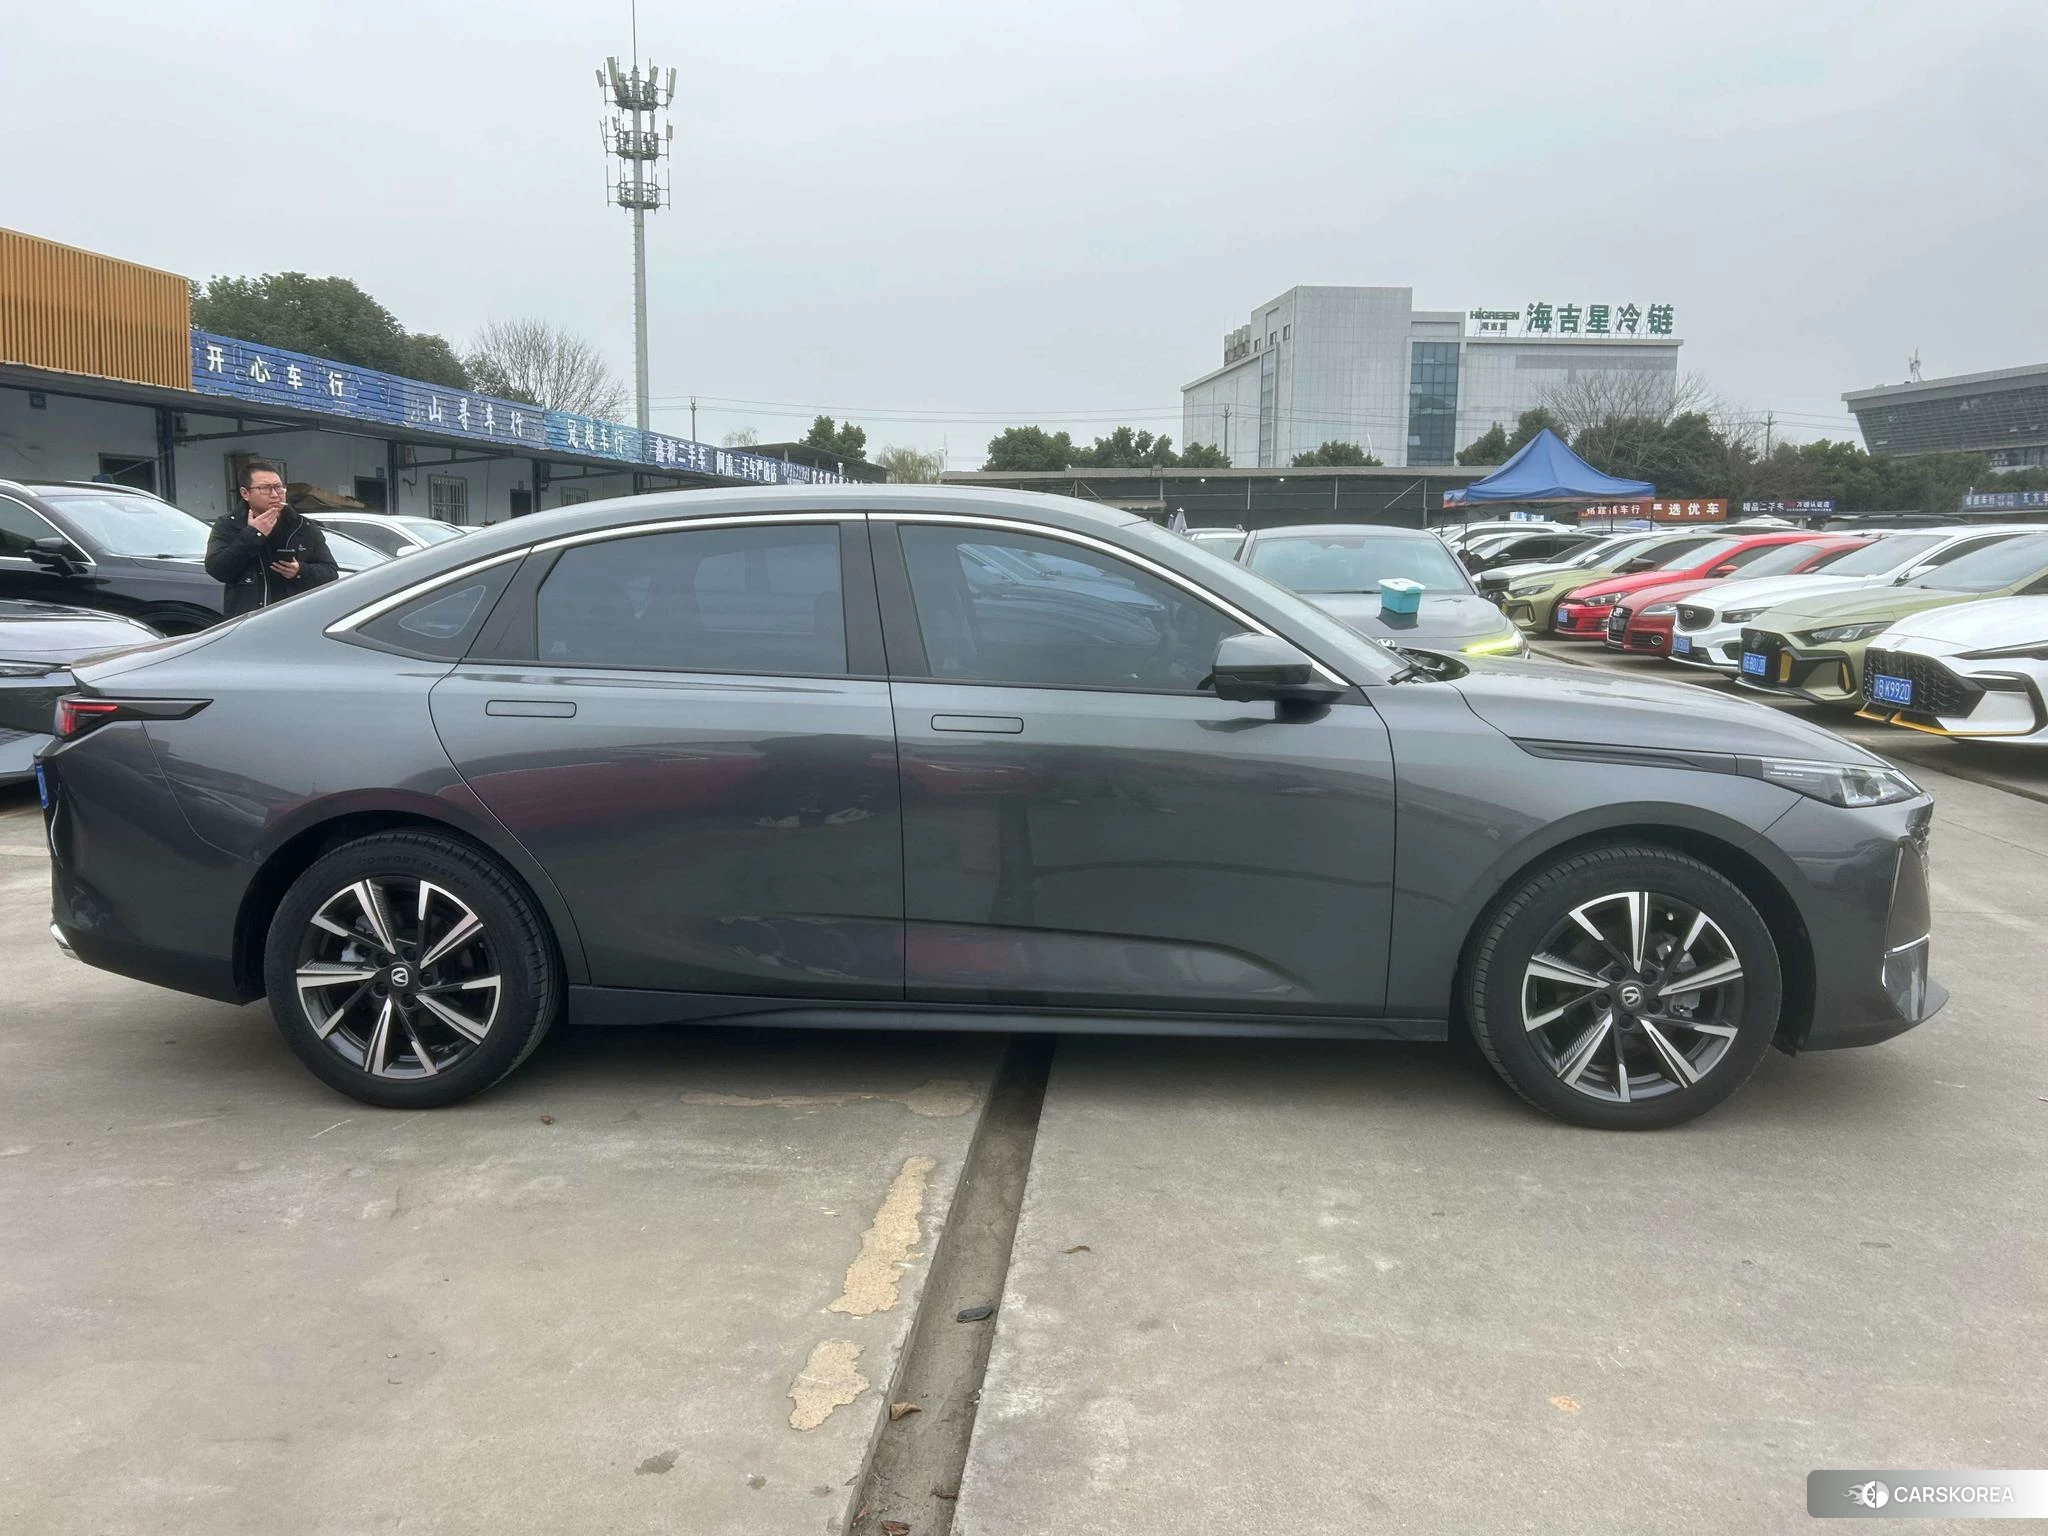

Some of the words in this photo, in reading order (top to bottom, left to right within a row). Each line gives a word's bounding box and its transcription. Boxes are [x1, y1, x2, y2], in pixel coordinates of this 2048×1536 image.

[1527, 302, 1673, 334] 海吉星冷链
[207, 345, 344, 397] 开心车行
[1653, 503, 1719, 516] 严选优车
